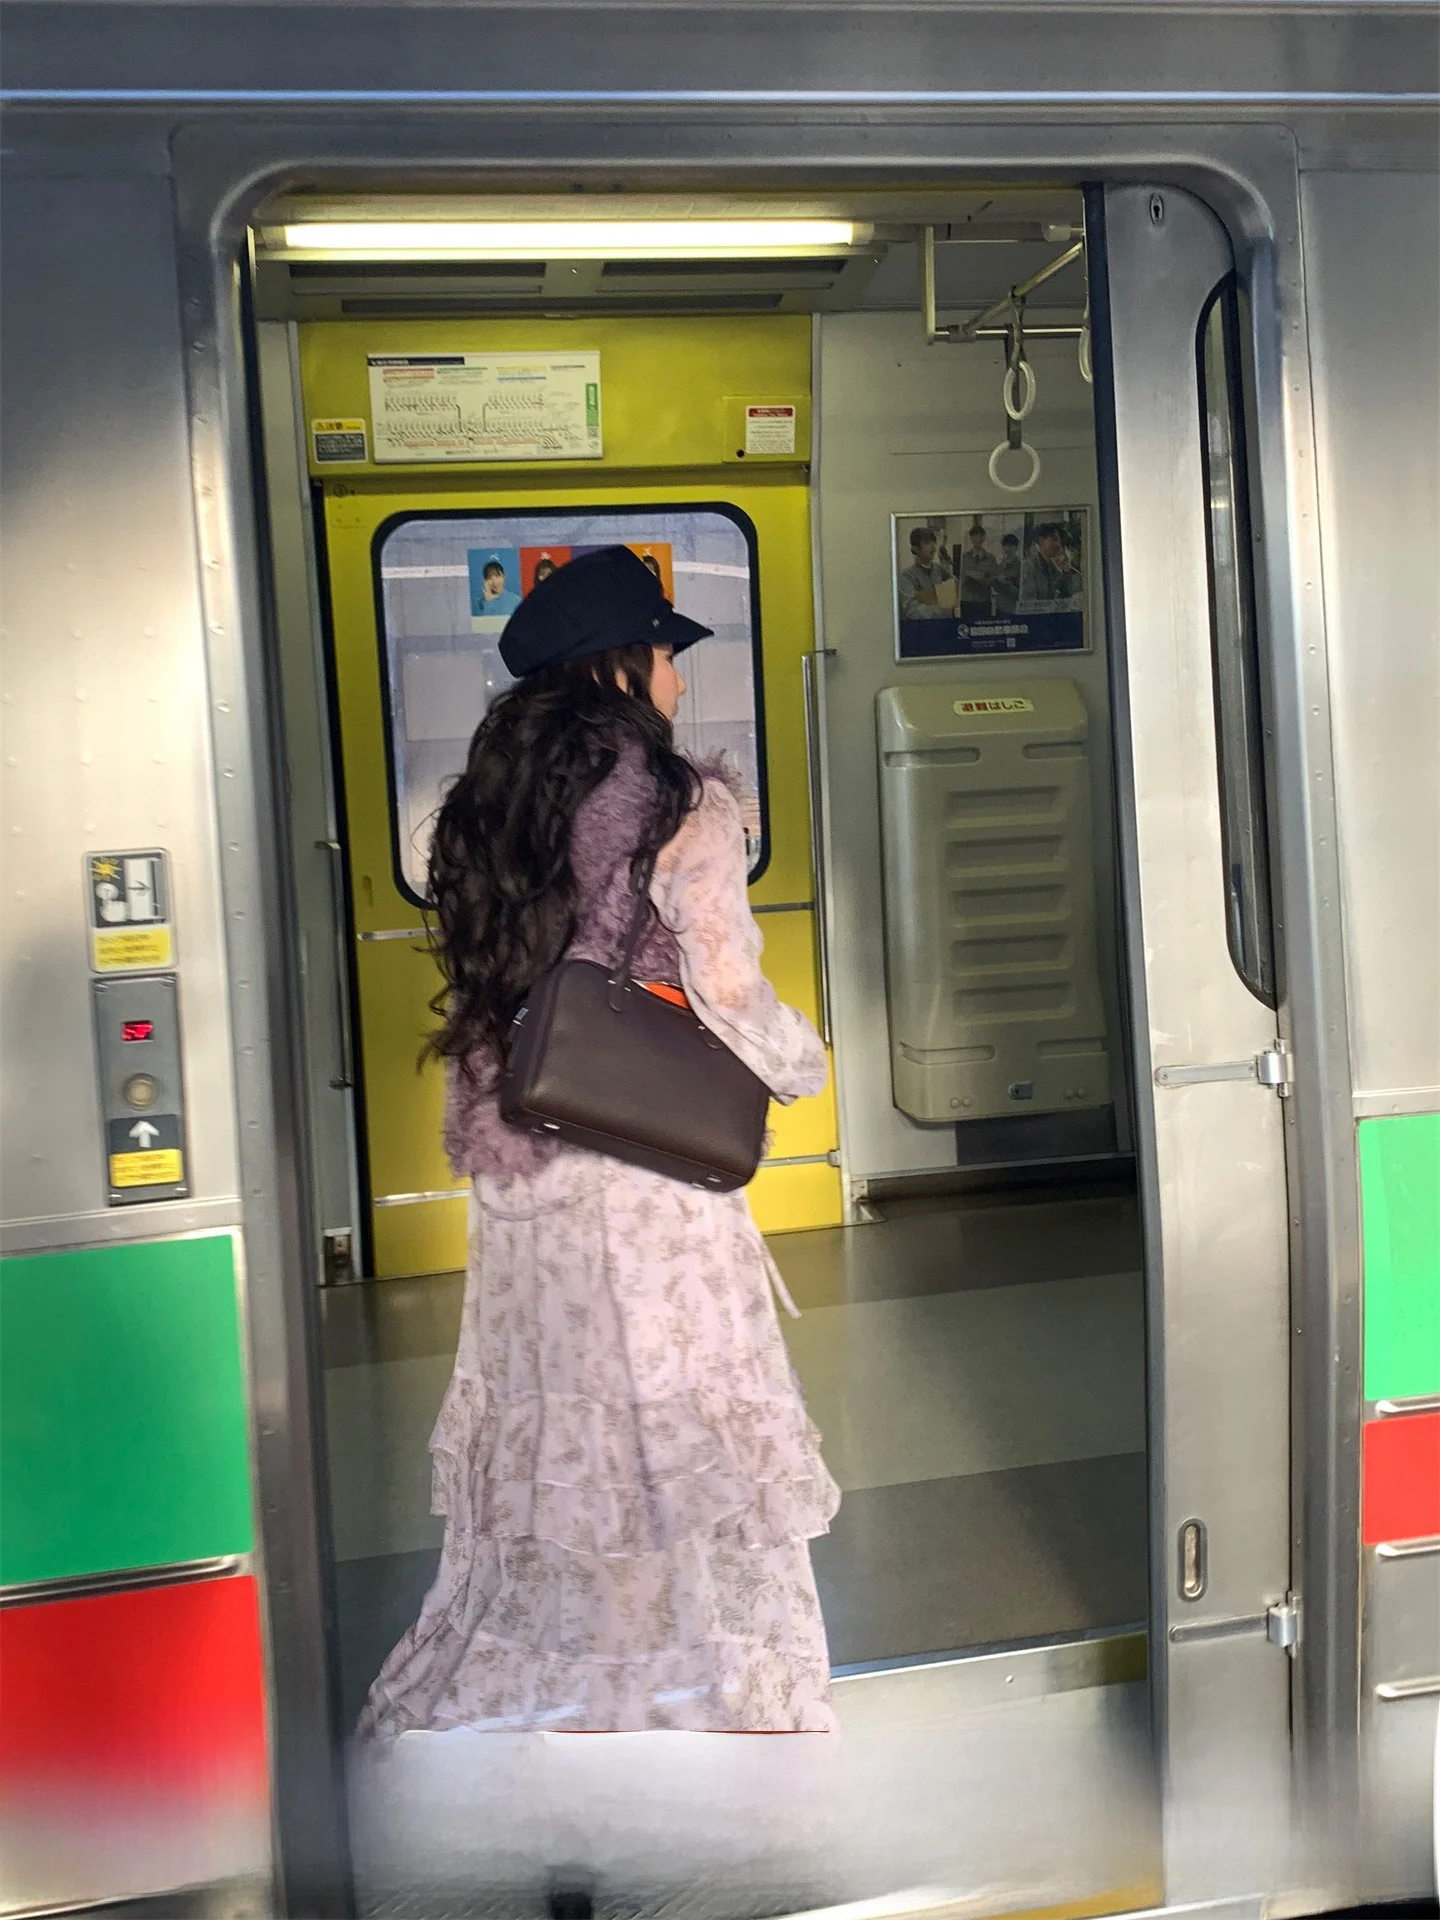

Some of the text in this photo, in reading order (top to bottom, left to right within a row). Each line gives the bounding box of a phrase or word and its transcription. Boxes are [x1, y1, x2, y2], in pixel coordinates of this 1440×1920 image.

[962, 699, 1026, 713] 避難はしご
